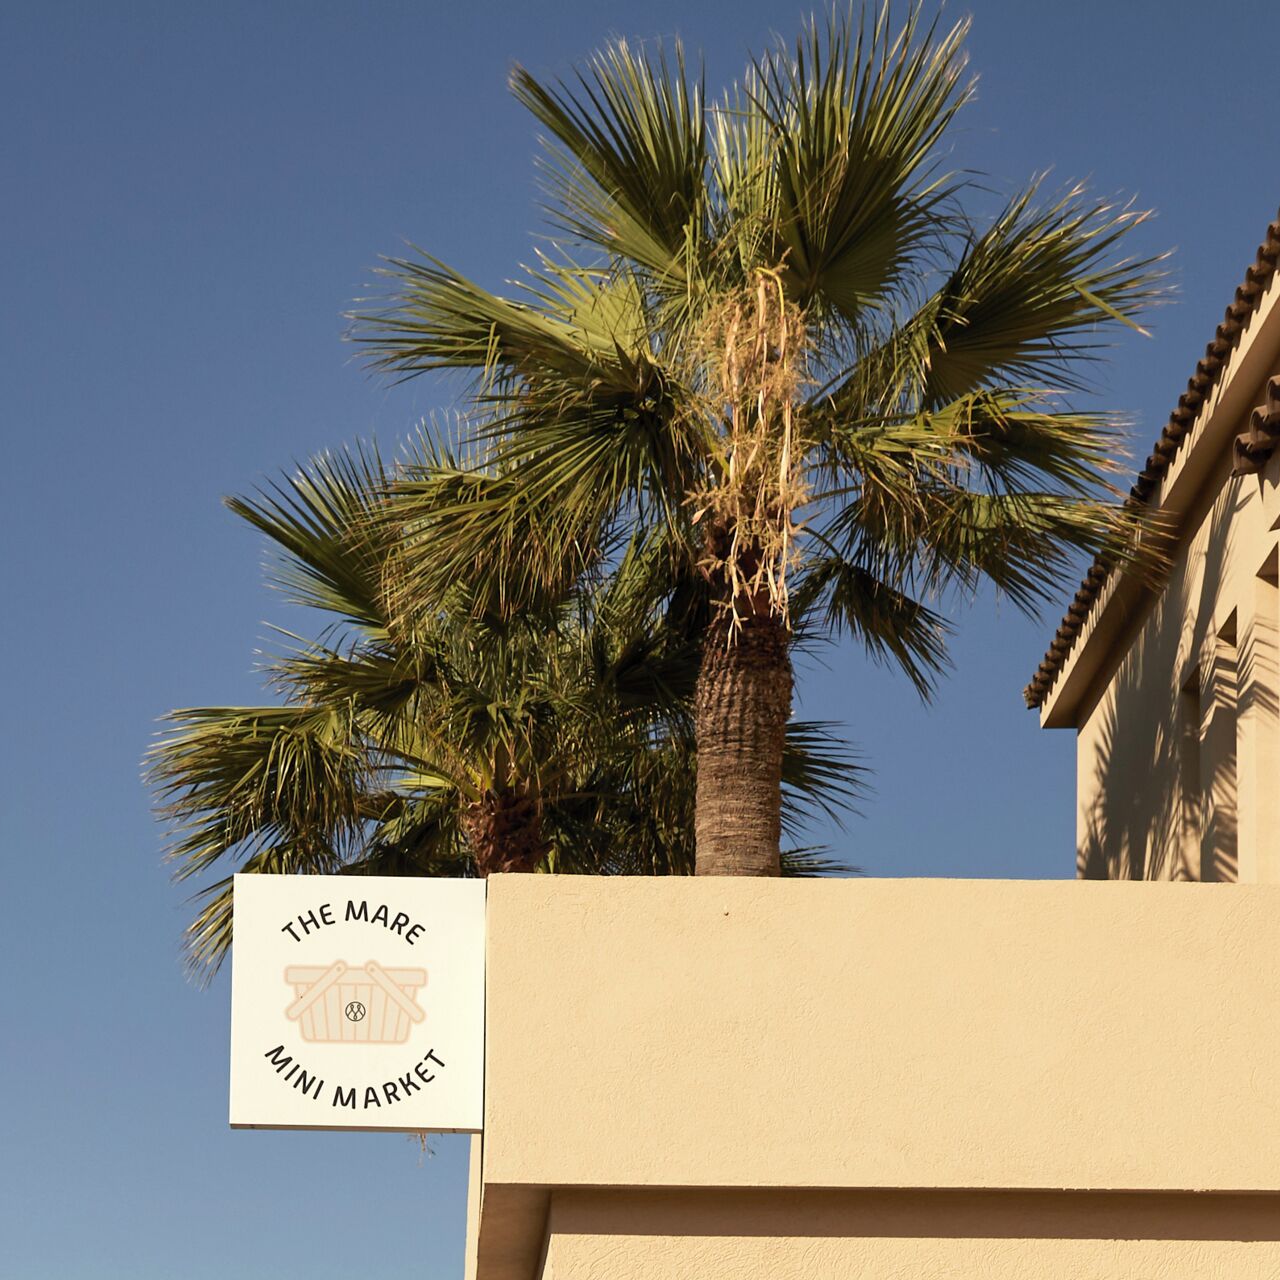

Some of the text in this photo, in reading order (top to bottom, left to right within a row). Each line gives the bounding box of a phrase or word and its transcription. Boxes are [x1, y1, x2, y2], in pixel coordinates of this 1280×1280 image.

[281, 900, 426, 946] THE MARE
[264, 1045, 446, 1110] MINI MARKET
